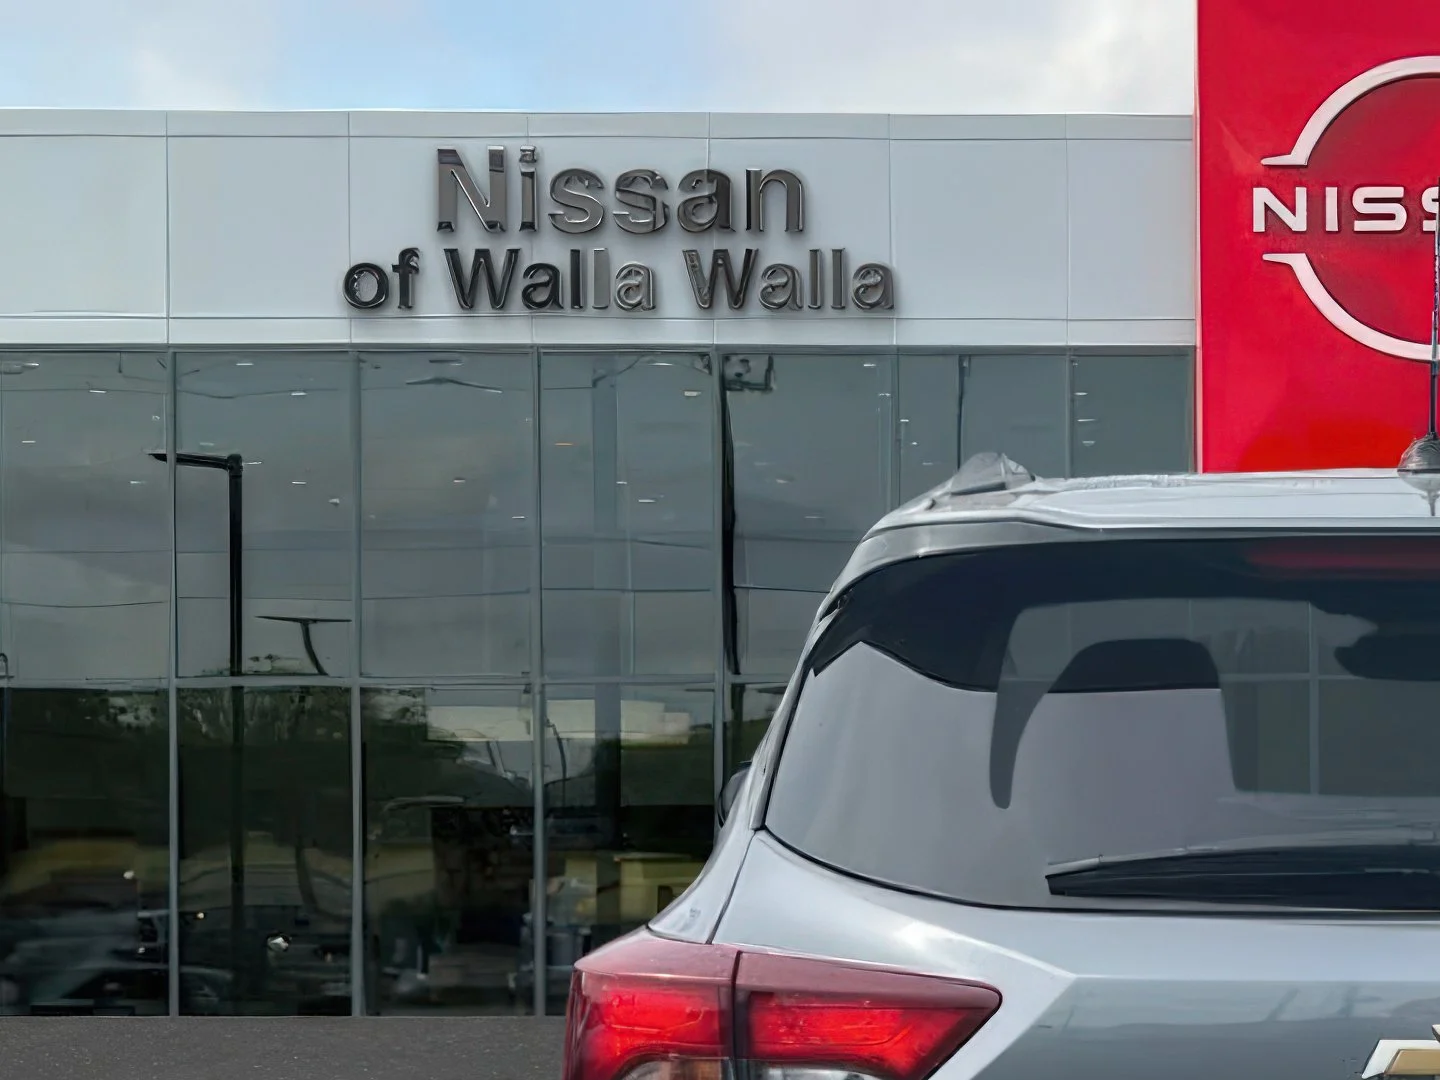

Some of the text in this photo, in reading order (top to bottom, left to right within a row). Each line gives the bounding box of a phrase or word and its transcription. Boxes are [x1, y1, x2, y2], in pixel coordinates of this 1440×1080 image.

[436, 145, 806, 234] Nissan
[343, 246, 895, 311] of Walla Walla
